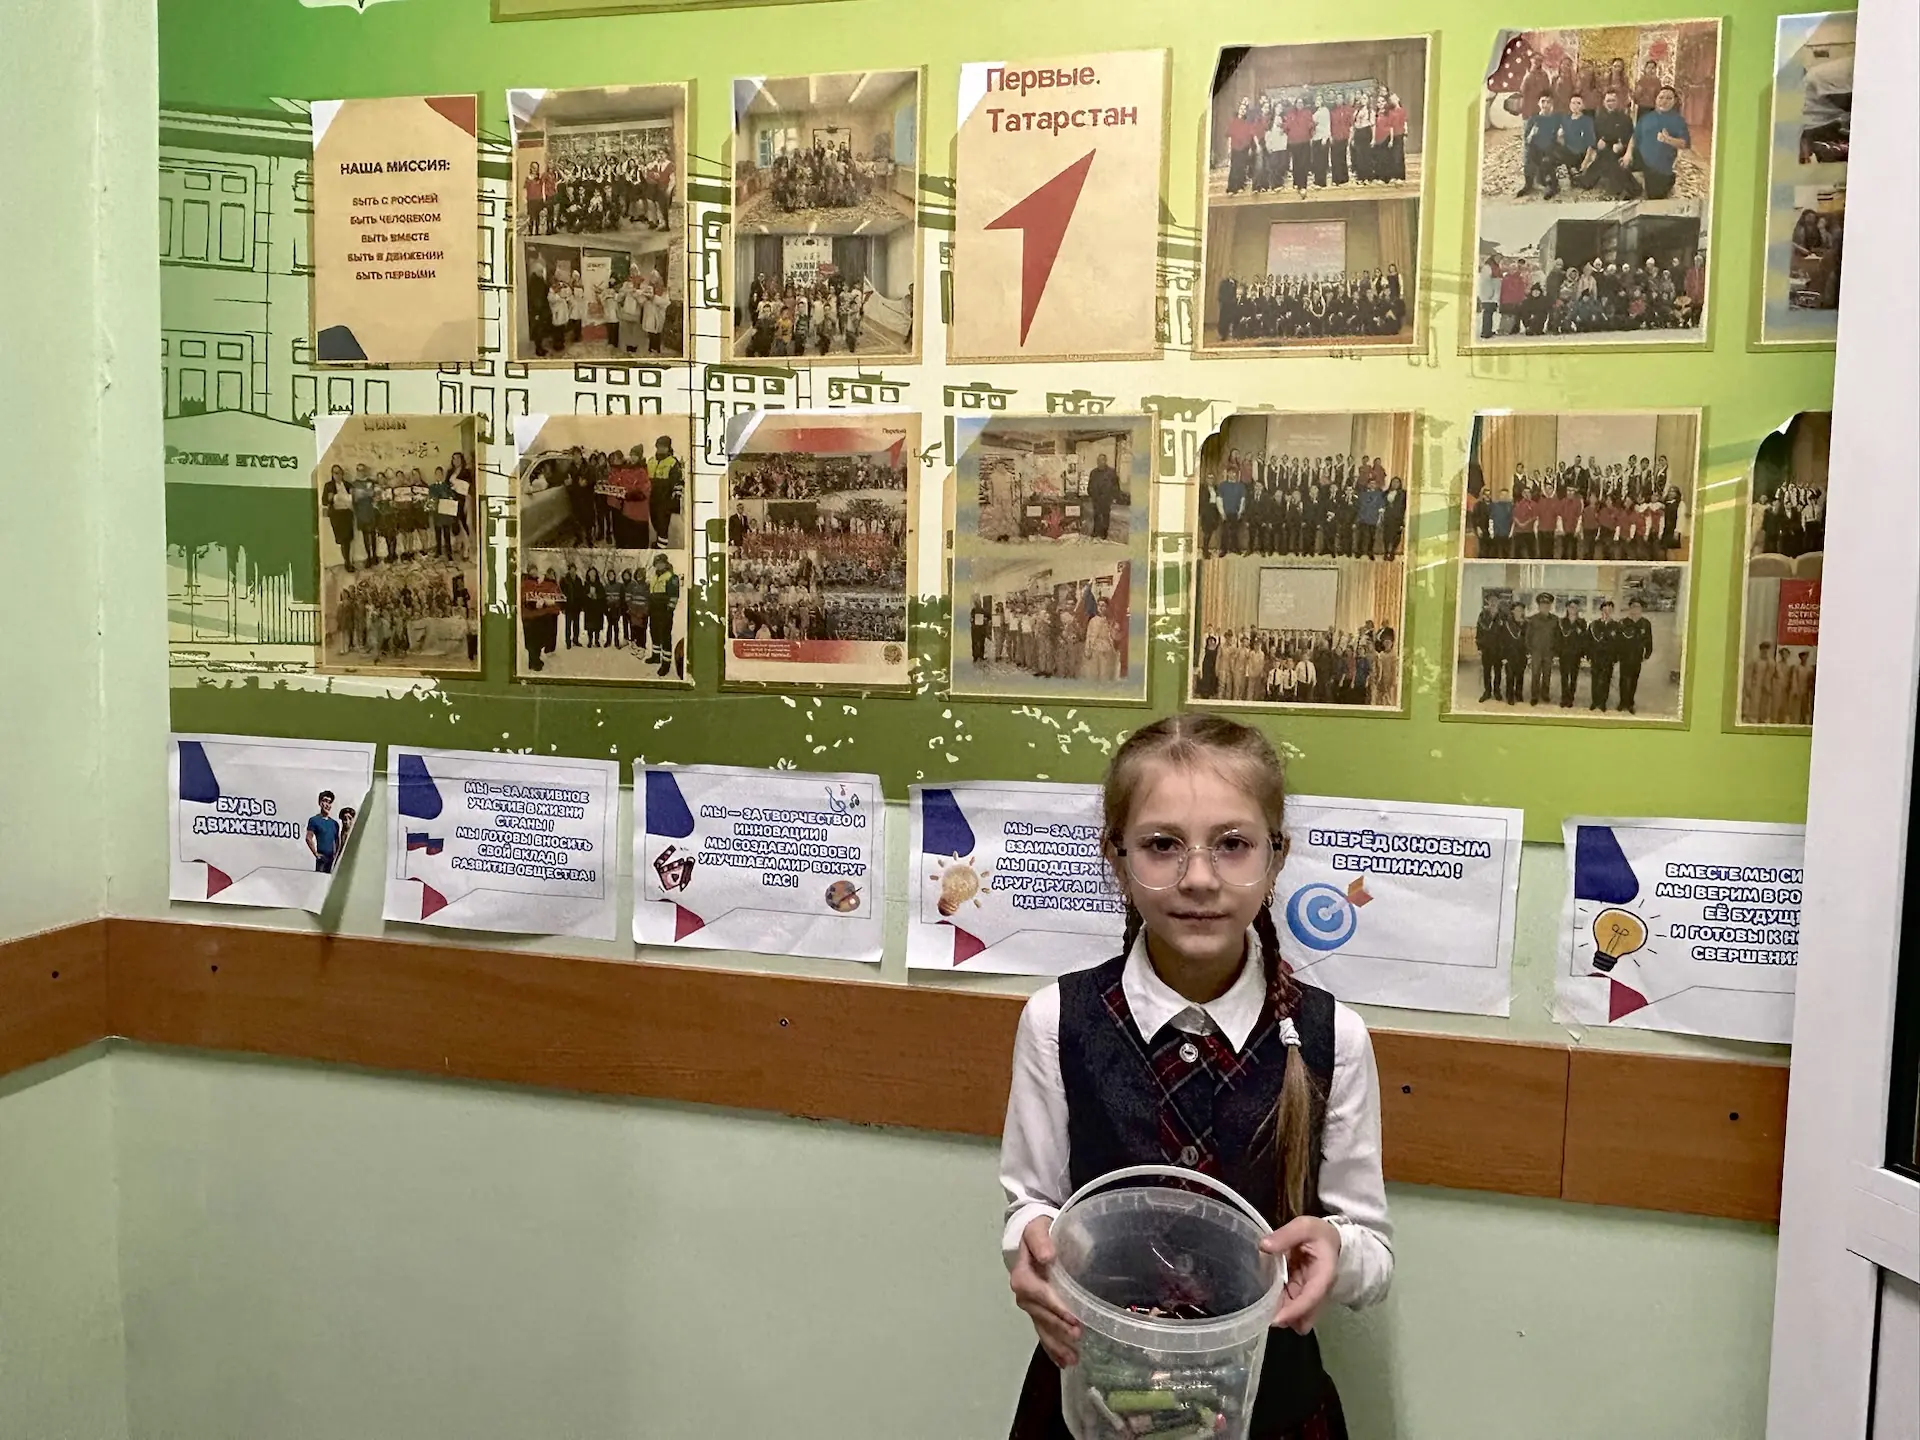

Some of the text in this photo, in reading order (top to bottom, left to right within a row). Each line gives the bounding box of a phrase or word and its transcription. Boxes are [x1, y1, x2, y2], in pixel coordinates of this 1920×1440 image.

[986, 66, 1100, 97] Первые.
[986, 106, 1138, 136] Татарстан
[340, 159, 451, 175] НАША МИССИЯ:
[352, 193, 439, 206] БЫТЬ С РОССИЕЙ
[350, 213, 441, 225] БЫТЬ ЧЕЛОВЕКОМ
[361, 232, 430, 243] БЫТЬ ВМЕСТЕ
[347, 253, 374, 262] БЫТЬ
[385, 251, 444, 262] ДВИЖЕНИИ
[355, 269, 437, 280] БЫТЬ ПЕРВЫМИ
[464, 781, 489, 795] МЫ
[502, 785, 520, 798] ЗА
[521, 787, 590, 804] АКТИВНОЕ
[216, 795, 277, 817] БУДЬ В
[467, 797, 584, 819] УЧАСТИЕ В ЖИЗНИ
[699, 804, 727, 819] МЫ
[742, 807, 762, 821] ЗА
[762, 808, 853, 827] ТВОРЧЕСТВО
[853, 814, 866, 828] И
[193, 815, 291, 839] ДВИЖЕНИИ
[495, 815, 547, 831] СТРАНЫ
[734, 823, 820, 842] ИННОВАЦИИ
[1004, 822, 1033, 835] МЫ
[1049, 824, 1071, 838] ЗА
[1071, 825, 1104, 840] ДРУ
[456, 826, 593, 852] МЫ ГОТОВЫ ВНОСИТЬ
[705, 836, 861, 860] МЫ СОЗДАЕМ НОВОЕ И
[1005, 839, 1101, 857] ВЗАИМОПОМ
[1309, 829, 1491, 858] ВПЕРЁД К НОВЫМ
[478, 842, 568, 865] СВОЙ ВКЛАД В
[516, 863, 589, 882] ОБЩЕСТВА
[698, 851, 867, 877] УЛУЧШАЕМ МИР ВОКРУГ
[996, 857, 1026, 871] МЫ
[1333, 853, 1451, 878] ВЕРШИНАМ
[1665, 863, 1741, 881] ВМЕСТЕ
[1743, 867, 1777, 884] МЫ
[762, 872, 792, 887] НАС
[992, 875, 1032, 890] ДРУГ
[1032, 877, 1083, 893] ДРУГА
[1085, 880, 1097, 894] И
[1656, 882, 1692, 898] МЫ
[1693, 884, 1760, 903] ВЕРИМ
[1761, 888, 1776, 903] В
[1013, 894, 1126, 914] ИДЕМ К УСПЕХ
[1703, 903, 1730, 921] ЕЁ
[1670, 924, 1686, 939] И
[1687, 926, 1764, 944] ГОТОВЫ
[1766, 929, 1782, 944] К
